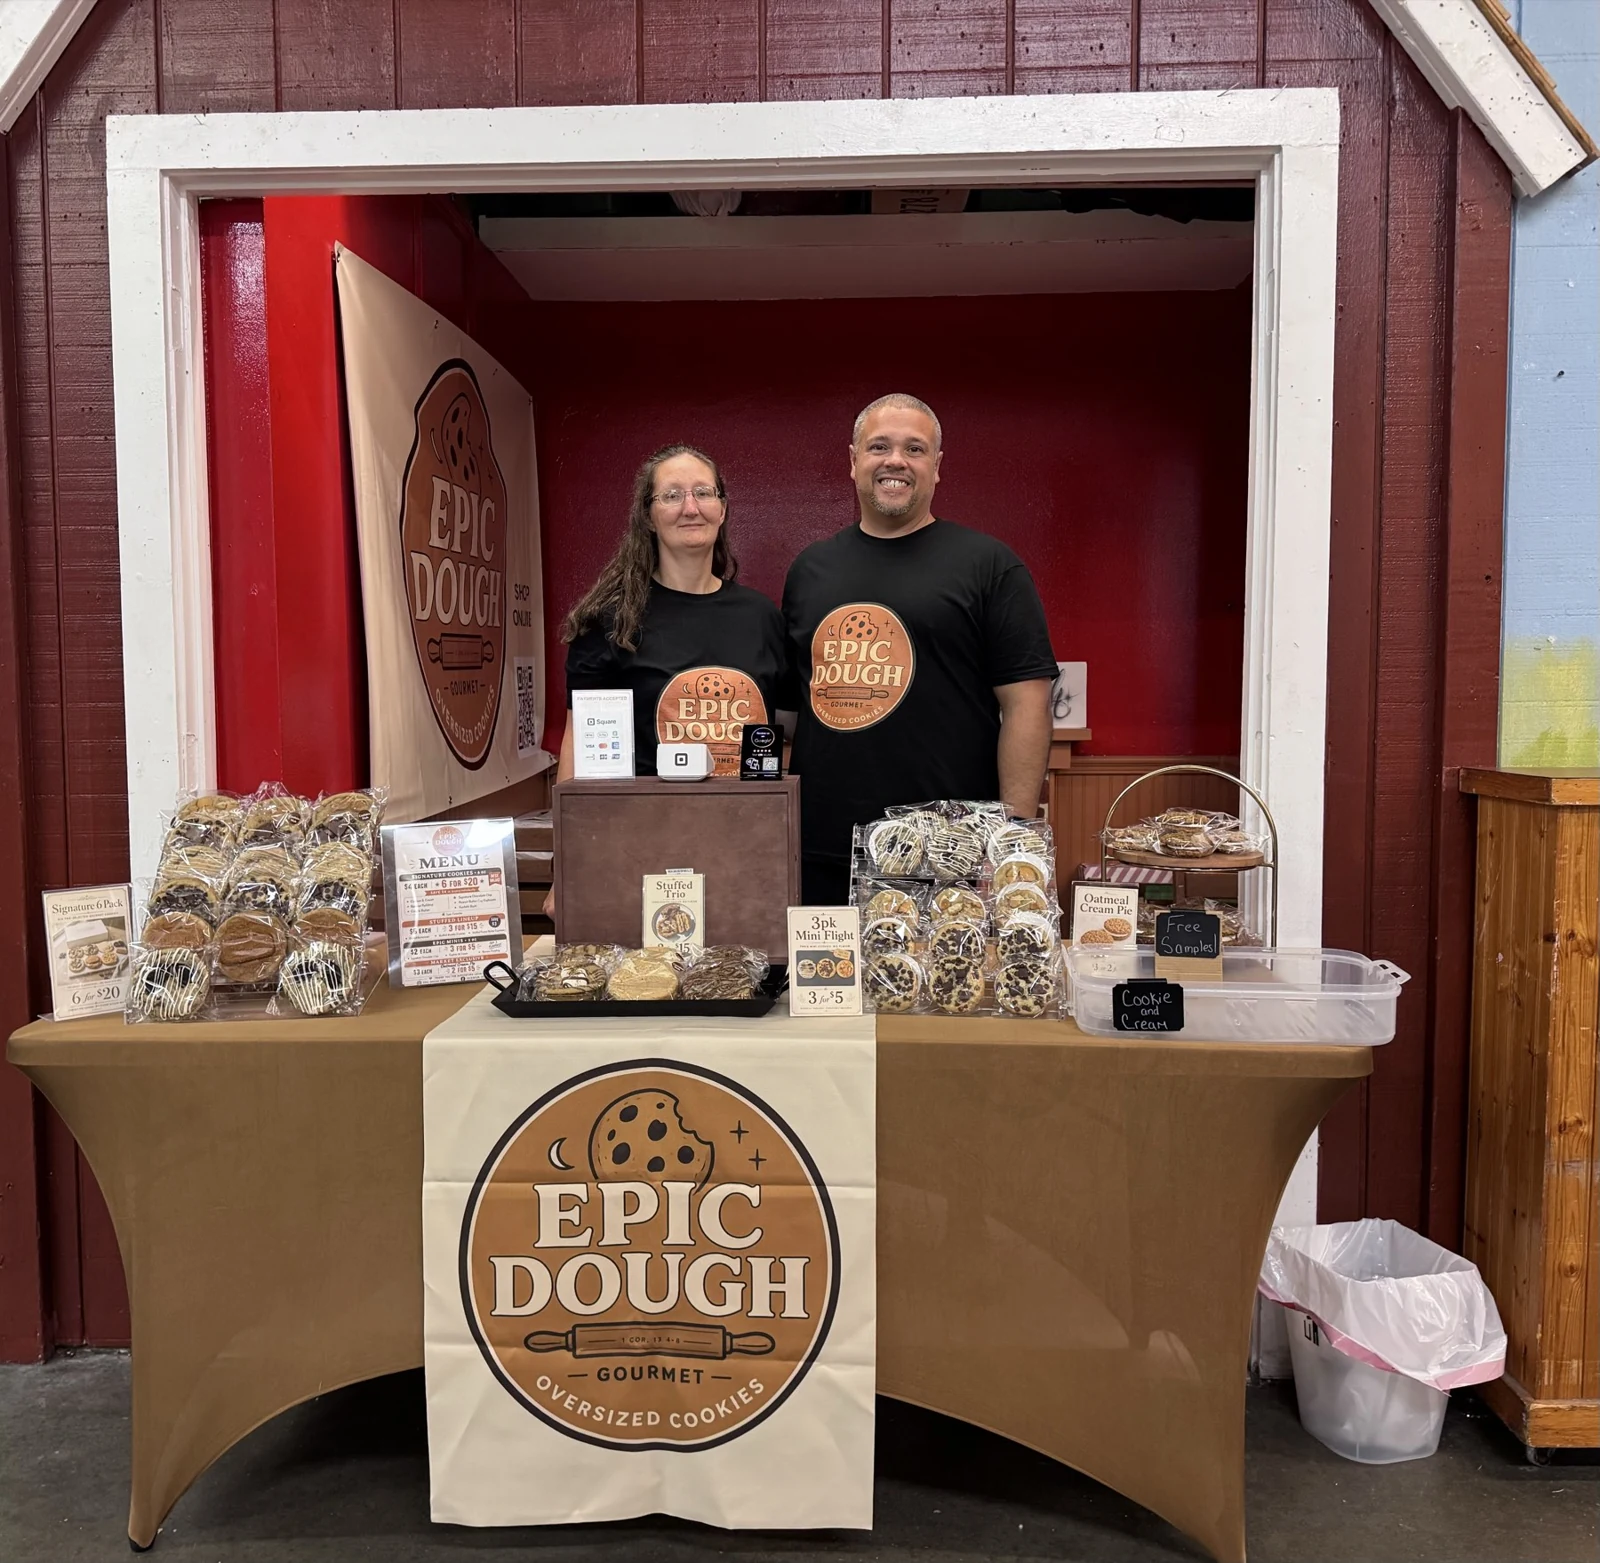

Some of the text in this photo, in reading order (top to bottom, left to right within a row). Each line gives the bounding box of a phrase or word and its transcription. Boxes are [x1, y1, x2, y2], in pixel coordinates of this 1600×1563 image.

[429, 476, 496, 562] EPIC
[410, 551, 500, 628] DOUGH
[514, 583, 530, 601] SHOP
[824, 640, 891, 662] EPIC
[814, 663, 904, 687] DOUGH
[450, 680, 478, 696] GOURMET
[436, 685, 495, 744] OVERSIZED COOKIES
[678, 698, 750, 721] EPIC
[816, 704, 884, 724] OVERSIZED COOKIES
[665, 722, 744, 741] DOUG
[419, 854, 480, 869] MENU
[441, 880, 447, 888] 6
[463, 877, 478, 886] $20
[656, 881, 692, 890] Stuffed
[664, 890, 686, 898] Trio
[1084, 894, 1129, 905] Oatmeal
[52, 898, 123, 915] Signature 6 Pack
[1080, 903, 1133, 915] Cream Pie
[812, 916, 837, 931] 3pk
[1166, 914, 1202, 934] Free
[796, 930, 854, 942] Mini Flight
[676, 943, 690, 954] $15
[72, 986, 120, 1004] 6 for $20
[808, 991, 843, 1004] 3 for $5
[1122, 989, 1172, 1007] Cookie
[1141, 1006, 1159, 1016] and
[1121, 1014, 1168, 1030] Cream
[533, 1180, 764, 1250] EPIC
[488, 1252, 810, 1318] DOUGH
[596, 1365, 704, 1384] GOURMET
[536, 1375, 764, 1428] OVERSIZED COOKIES
